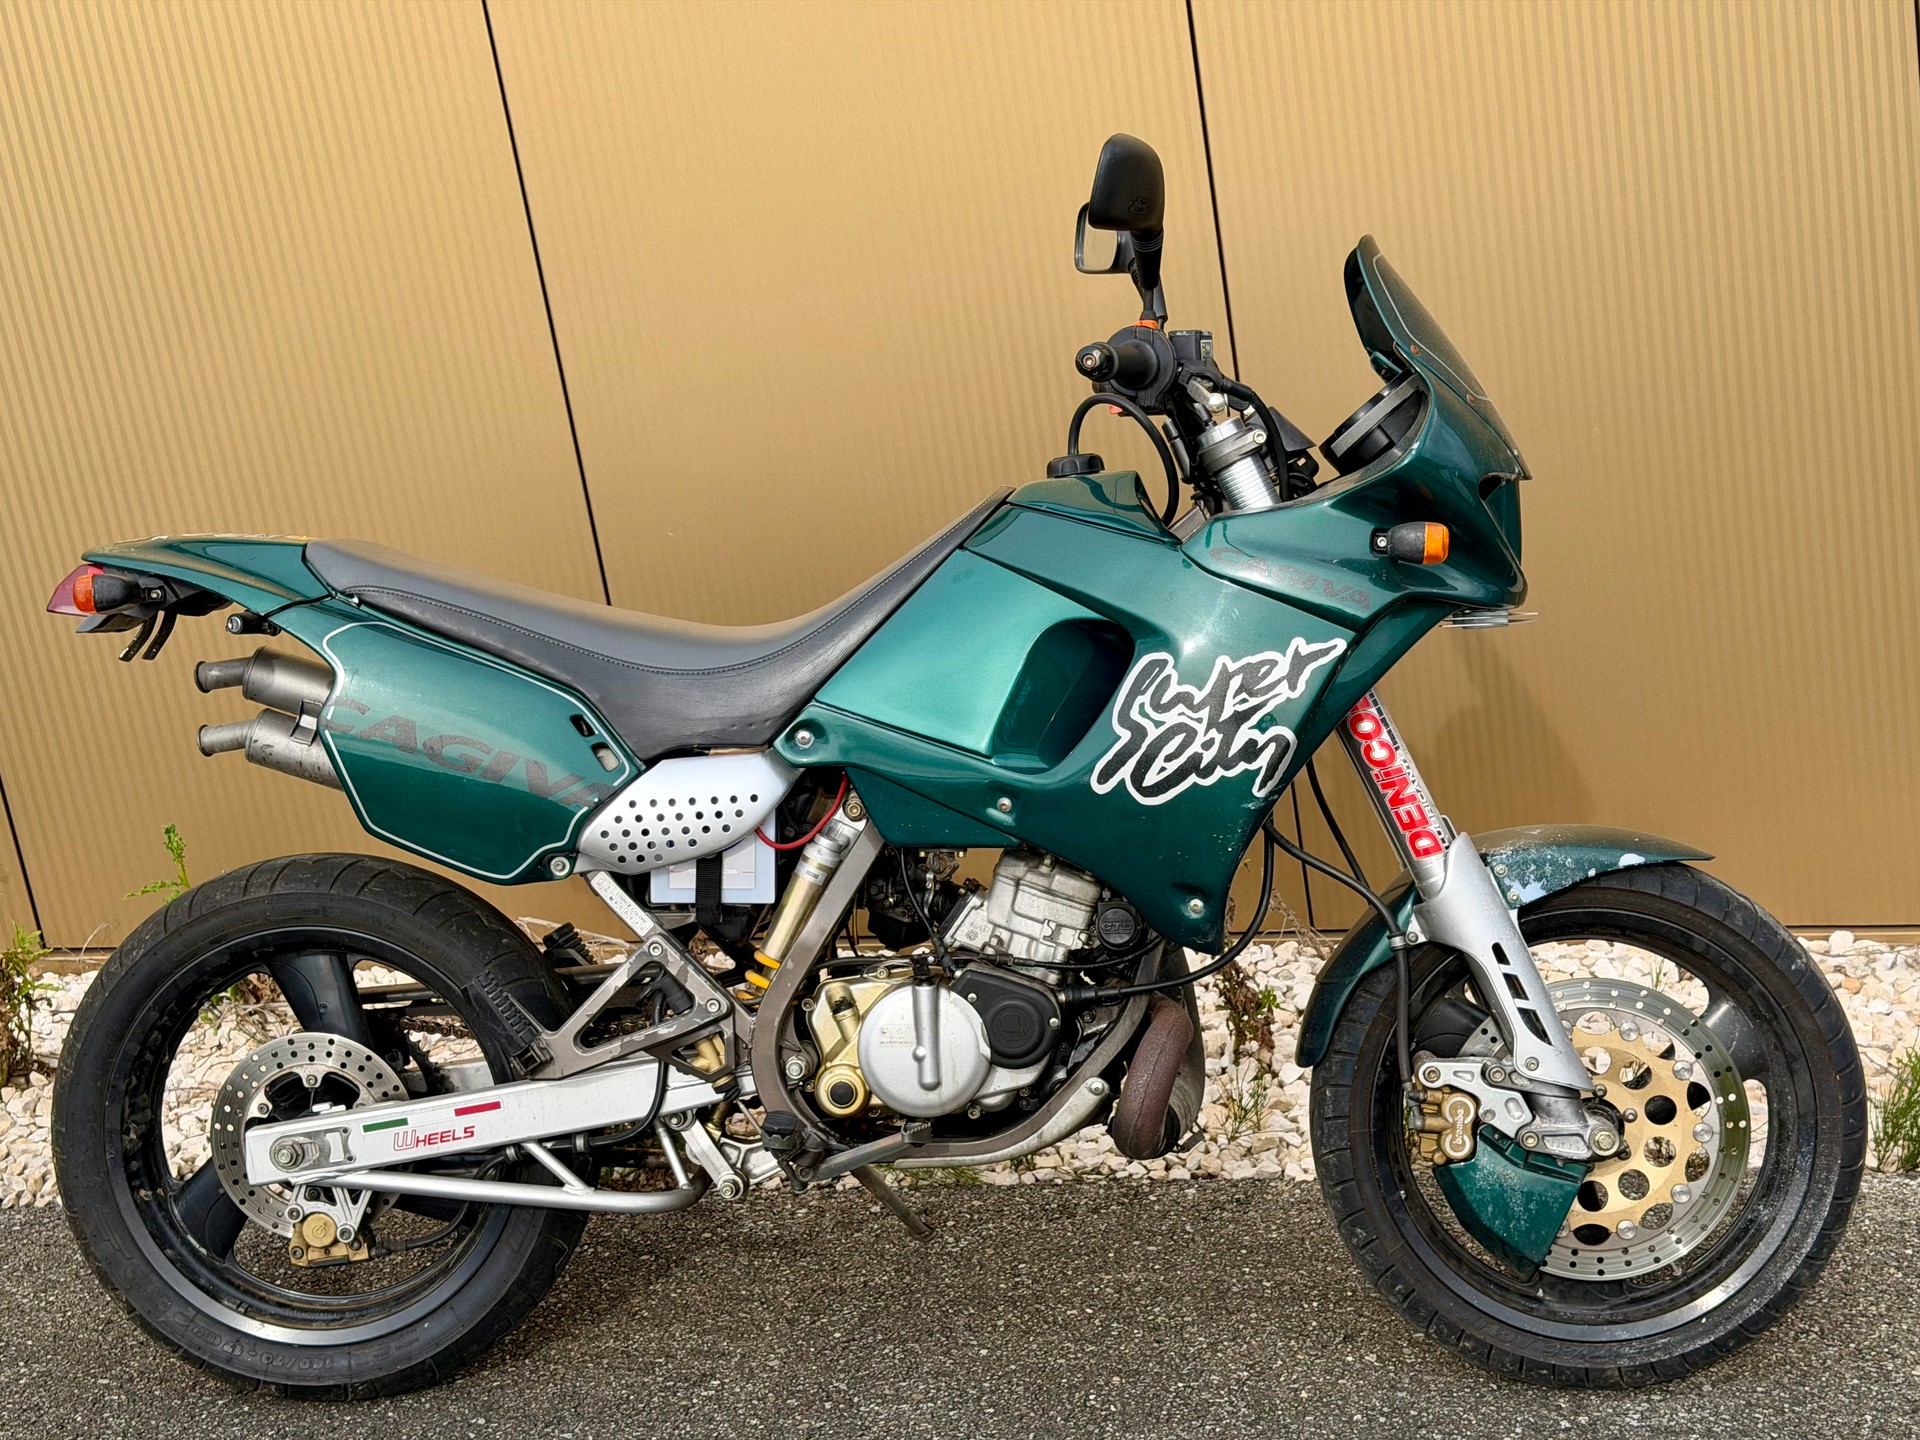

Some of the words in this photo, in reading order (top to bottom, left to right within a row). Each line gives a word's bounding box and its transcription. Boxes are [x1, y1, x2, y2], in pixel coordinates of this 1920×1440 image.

[1210, 547, 1371, 610] CAGIVA
[1092, 639, 1346, 793] Super
[1127, 692, 1296, 804] City
[1101, 921, 1133, 931] CTS
[393, 1125, 476, 1151] WHEELS
[1452, 1109, 1464, 1145] brembo
